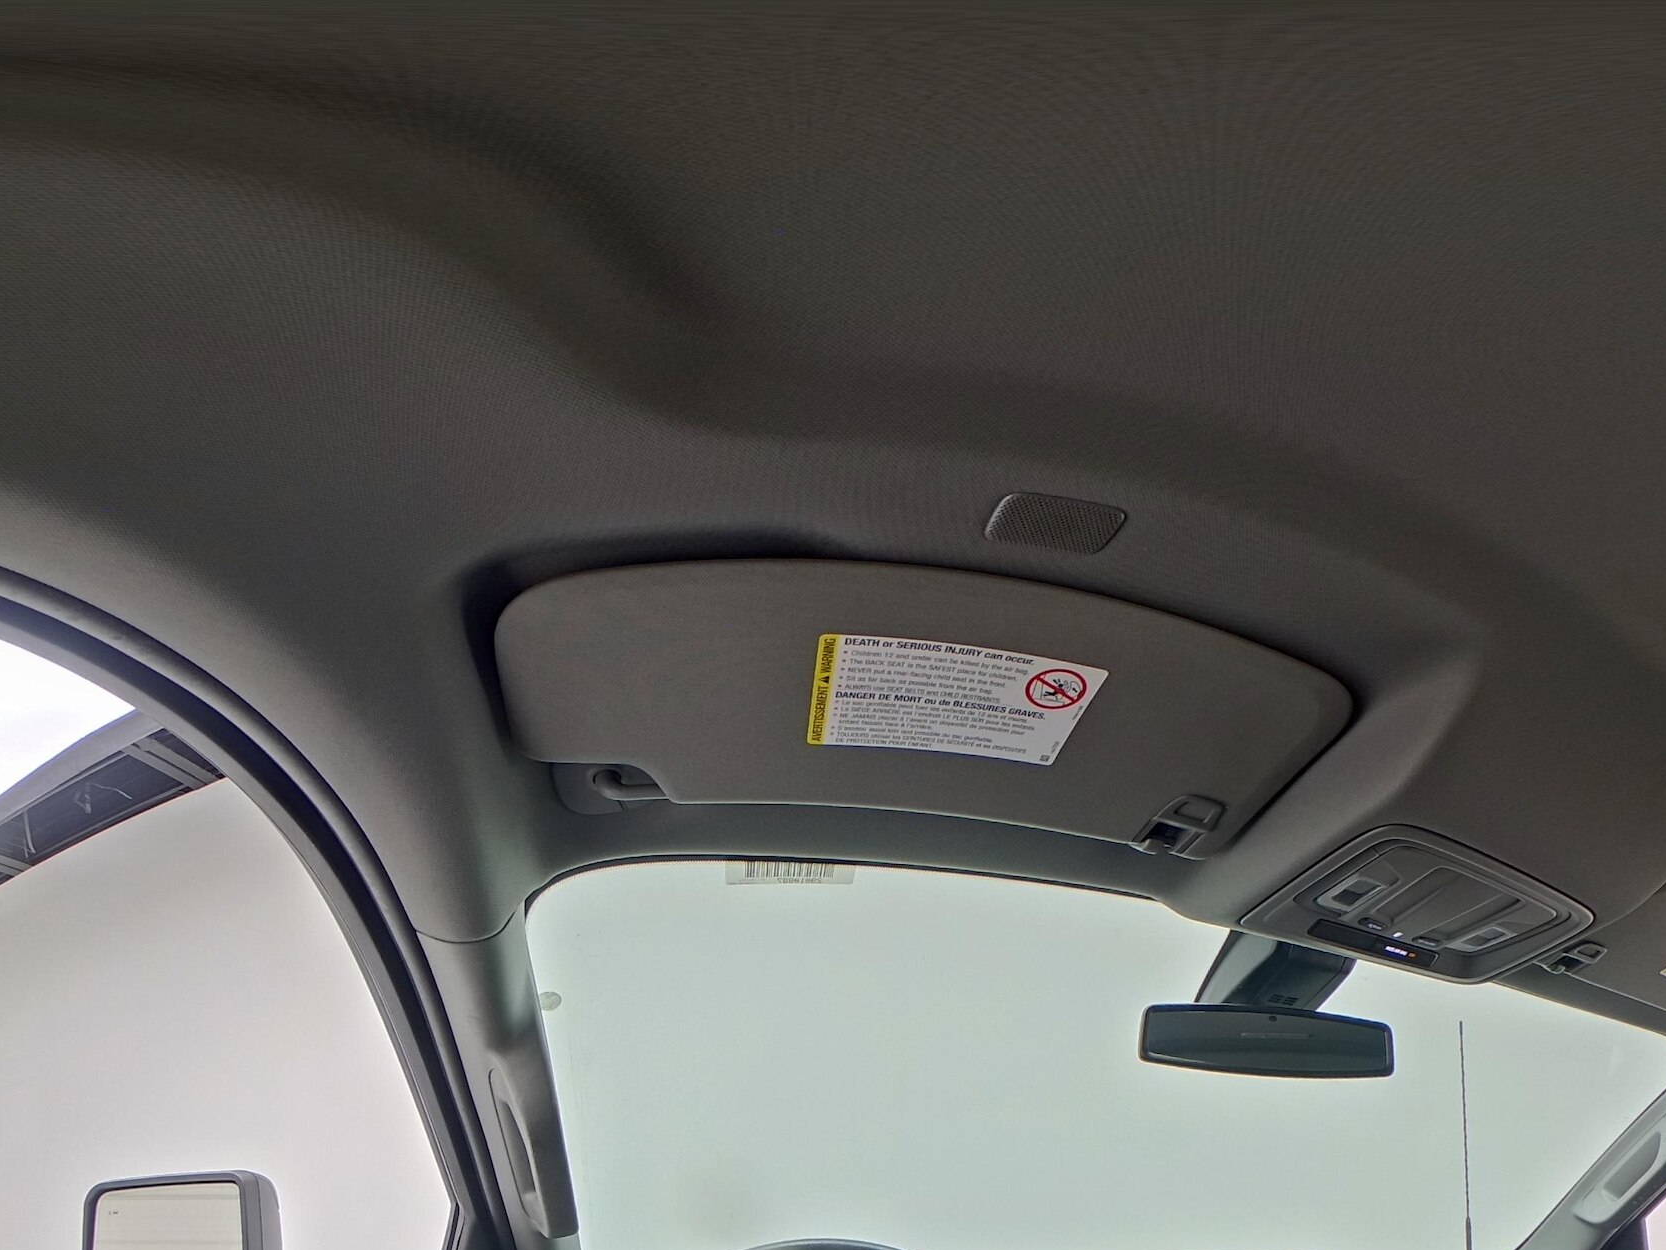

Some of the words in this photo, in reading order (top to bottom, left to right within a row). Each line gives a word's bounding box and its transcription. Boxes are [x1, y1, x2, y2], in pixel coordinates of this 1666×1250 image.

[844, 637, 879, 647] DEATH
[896, 641, 942, 653] SERIOUS
[944, 645, 983, 657] INJURY
[984, 652, 1003, 660] can
[1005, 655, 1035, 665] occur.
[851, 650, 882, 658] Children
[811, 685, 829, 742] AVERTISSEMENT
[820, 638, 836, 674] WARNING
[835, 691, 876, 700] DANGER
[878, 693, 892, 701] DE
[894, 694, 923, 703] MORT
[953, 700, 1007, 713] BLESSURES
[1008, 707, 1045, 720] GRAVES.
